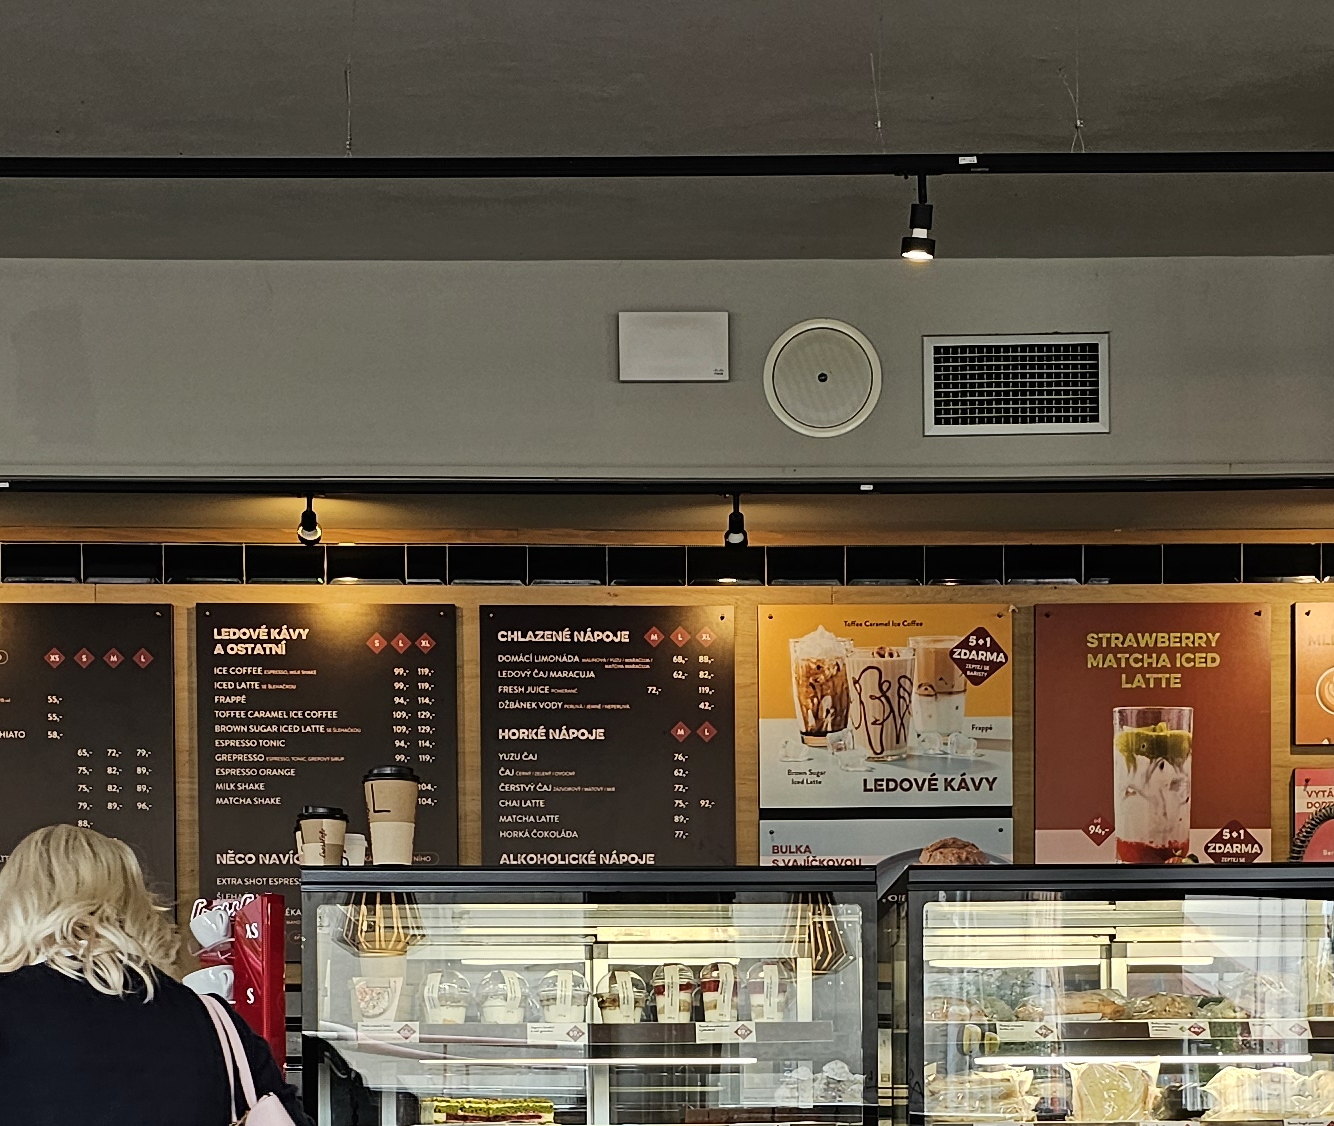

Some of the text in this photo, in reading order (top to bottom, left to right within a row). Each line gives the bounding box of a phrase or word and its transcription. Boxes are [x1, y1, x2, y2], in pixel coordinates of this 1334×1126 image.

[214, 624, 309, 639] LEDOVÉ KÁVY
[498, 628, 629, 642] CHLAZENÉ NÁPOJE
[1087, 633, 1220, 648] STRAWBERRY
[214, 641, 286, 655] A OSTATNÍ
[498, 653, 579, 662] DOMÁCÍ LIMONÁDA
[952, 649, 1005, 663] ZDARMA
[1088, 653, 1220, 668] MATCHA ICED
[498, 669, 531, 678] LEDOVÝ
[533, 669, 548, 678] ČAJ
[1122, 674, 1181, 688] LATTE
[47, 695, 63, 704] 55,-
[215, 694, 246, 703] FRAPPÉ
[499, 700, 537, 709] DŽBÁNEK
[538, 701, 563, 709] VODY
[215, 710, 246, 718] TOFFEE
[248, 710, 288, 718] CARAMEL
[290, 710, 303, 718] ICE
[305, 710, 338, 718] COFFEE
[393, 711, 411, 720] 109,-
[215, 725, 247, 733] BROWN
[249, 725, 278, 733] SUGAR
[280, 725, 300, 733] ICED
[302, 725, 325, 733] LATTE
[972, 724, 992, 732] Frappé
[499, 726, 605, 740] HORKÉ NÁPOJE
[215, 739, 285, 747] ESPRESSO TONIC
[107, 749, 122, 758] 72,-
[136, 749, 151, 758] 79,-
[215, 754, 264, 762] GREPRESSO
[522, 752, 537, 761] ČAJ
[216, 783, 265, 791] MILK SHAKE
[863, 773, 997, 792] LEDOVÉ KÁVY
[499, 815, 559, 823] MATCHA LATTE
[499, 829, 578, 838] HORKÁ ČOKOLÁDA
[772, 845, 812, 854] BULKA
[1208, 844, 1260, 854] ZDARMA
[216, 851, 256, 865] NĚCO
[500, 851, 655, 865] ALKOHOLICKÉ NÁPOJE
[247, 988, 254, 1004] S
